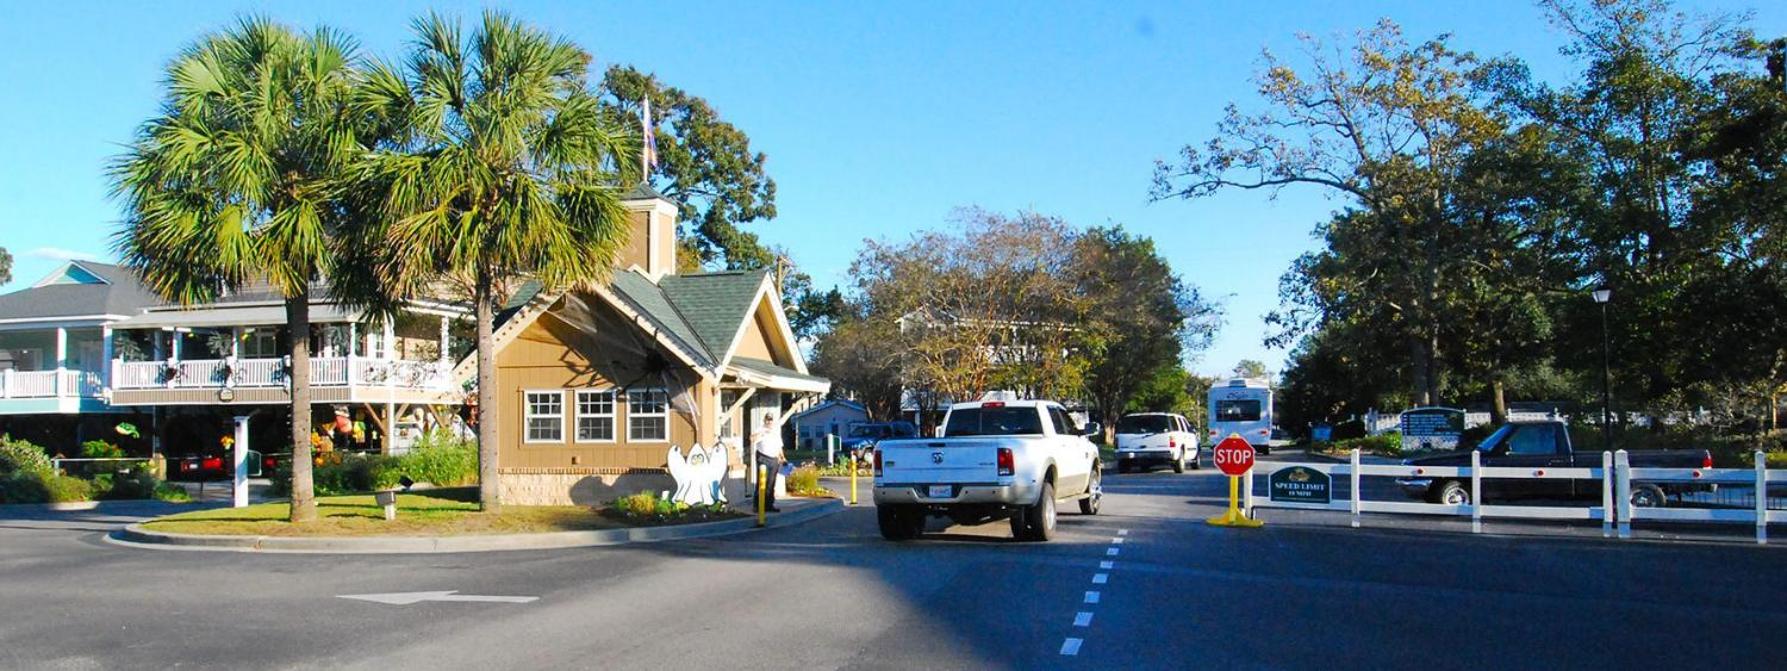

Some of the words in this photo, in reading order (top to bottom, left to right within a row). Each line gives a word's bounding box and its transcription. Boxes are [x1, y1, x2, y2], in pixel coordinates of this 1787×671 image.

[1217, 449, 1251, 464] STOP
[1275, 482, 1300, 490] SPEED
[1301, 483, 1324, 491] LIMIT
